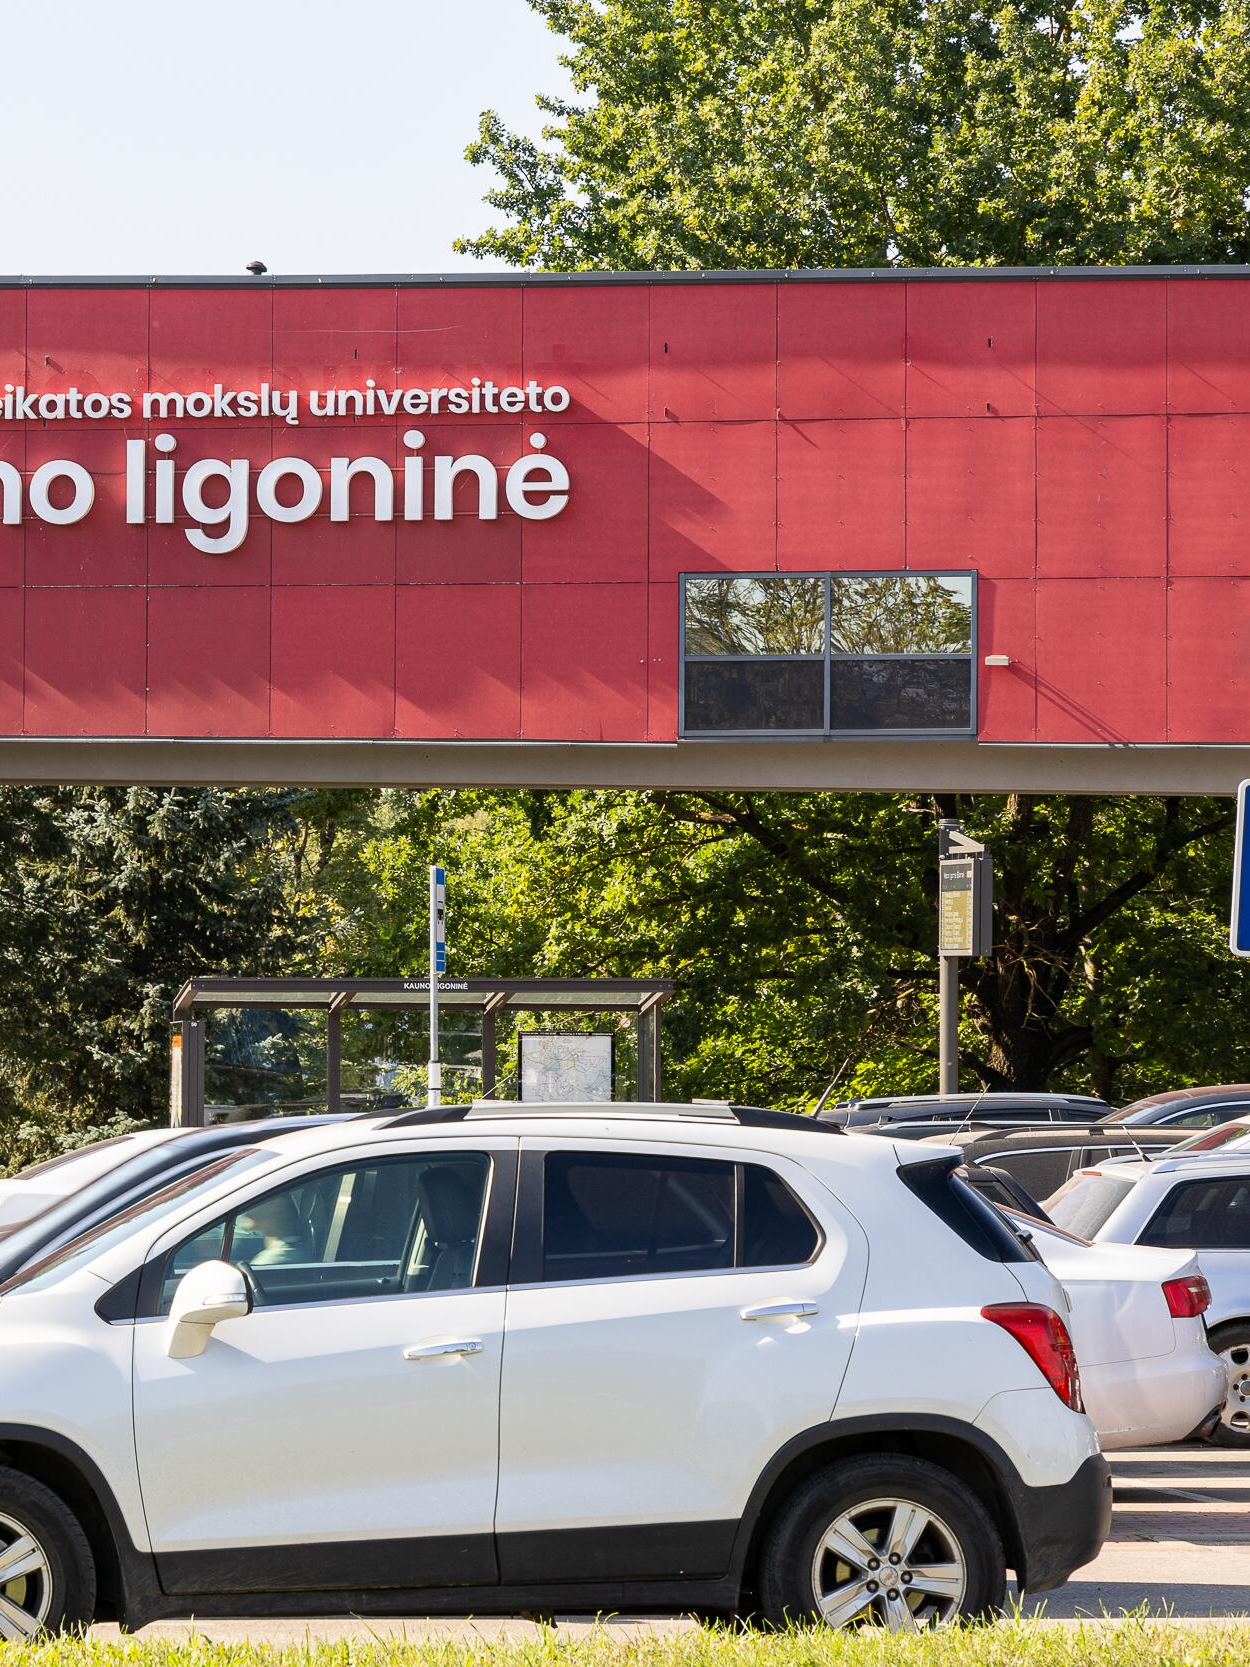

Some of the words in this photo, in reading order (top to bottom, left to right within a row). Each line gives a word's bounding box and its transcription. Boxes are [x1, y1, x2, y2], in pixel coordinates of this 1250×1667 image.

[142, 382, 300, 426] mokslų
[308, 377, 571, 417] universiteto
[125, 428, 571, 555] ligoninė
[403, 982, 431, 990] KAUNO
[437, 982, 468, 990] IGONINĖ
